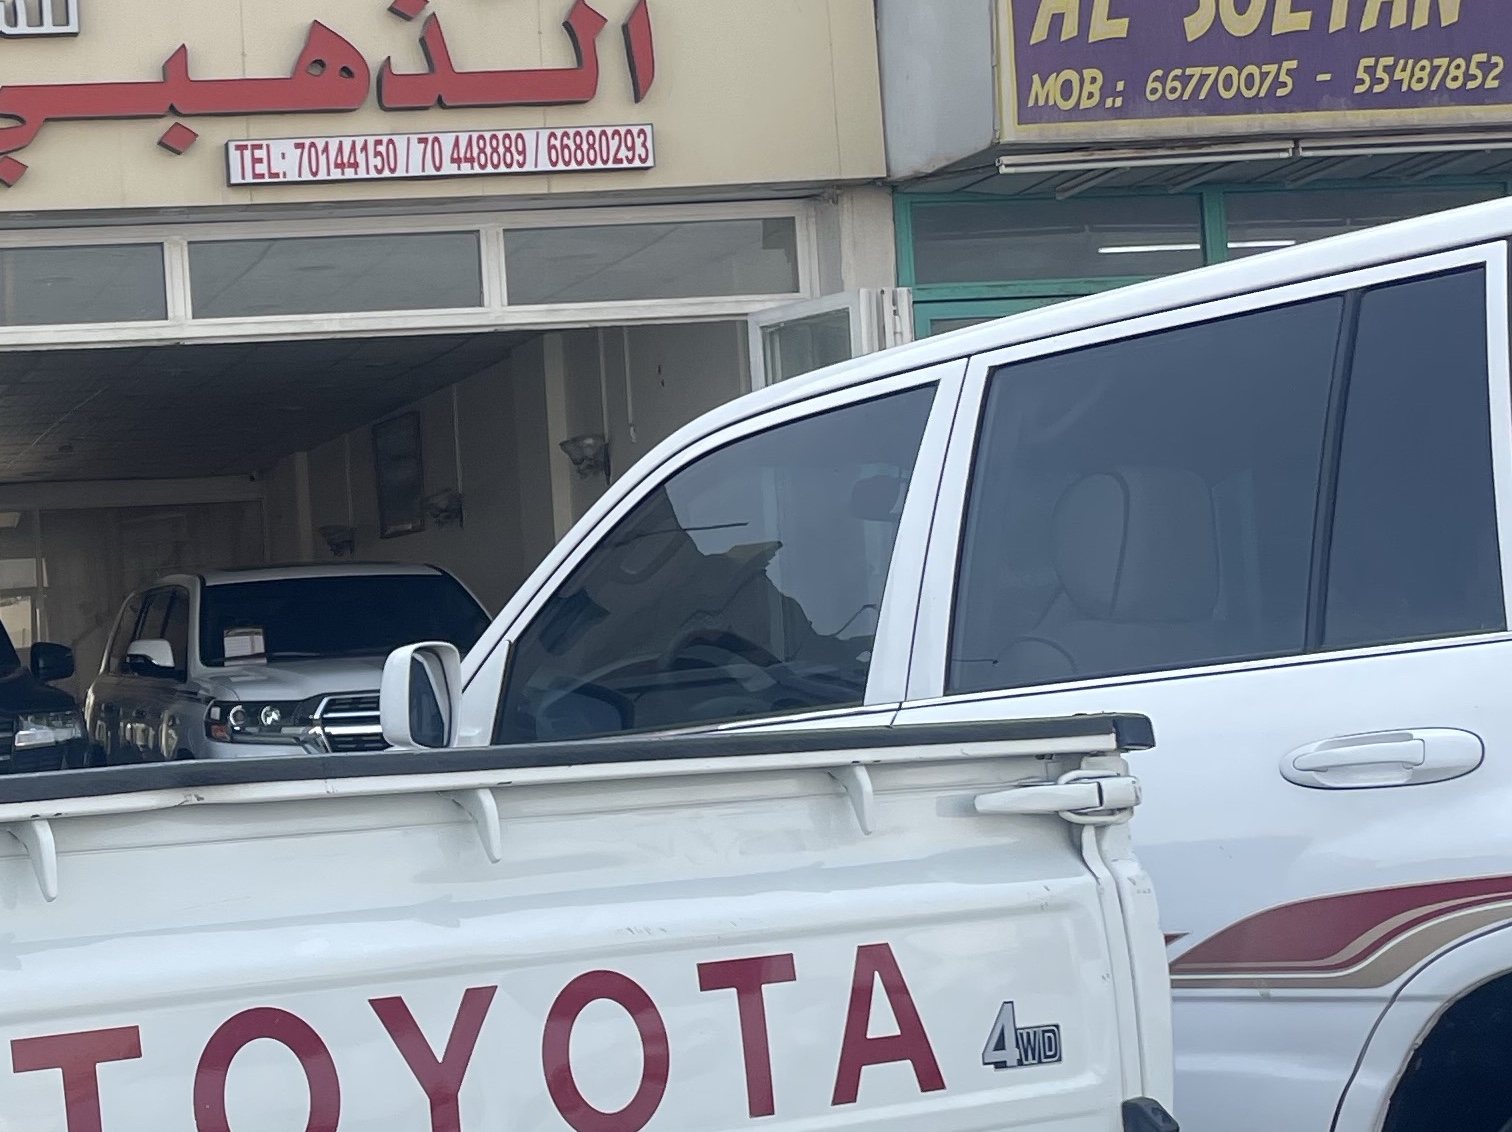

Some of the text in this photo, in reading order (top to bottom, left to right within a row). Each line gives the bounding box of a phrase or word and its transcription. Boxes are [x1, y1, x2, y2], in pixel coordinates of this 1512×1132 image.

[1144, 59, 1298, 102] 66770075
[1353, 52, 1506, 95] 55487852
[234, 144, 288, 182] TEL:
[293, 138, 398, 178] 70144150
[417, 136, 443, 173] 70
[449, 133, 527, 171] 448889
[546, 128, 651, 167] 66880293
[981, 1000, 1064, 1072] 4WD
